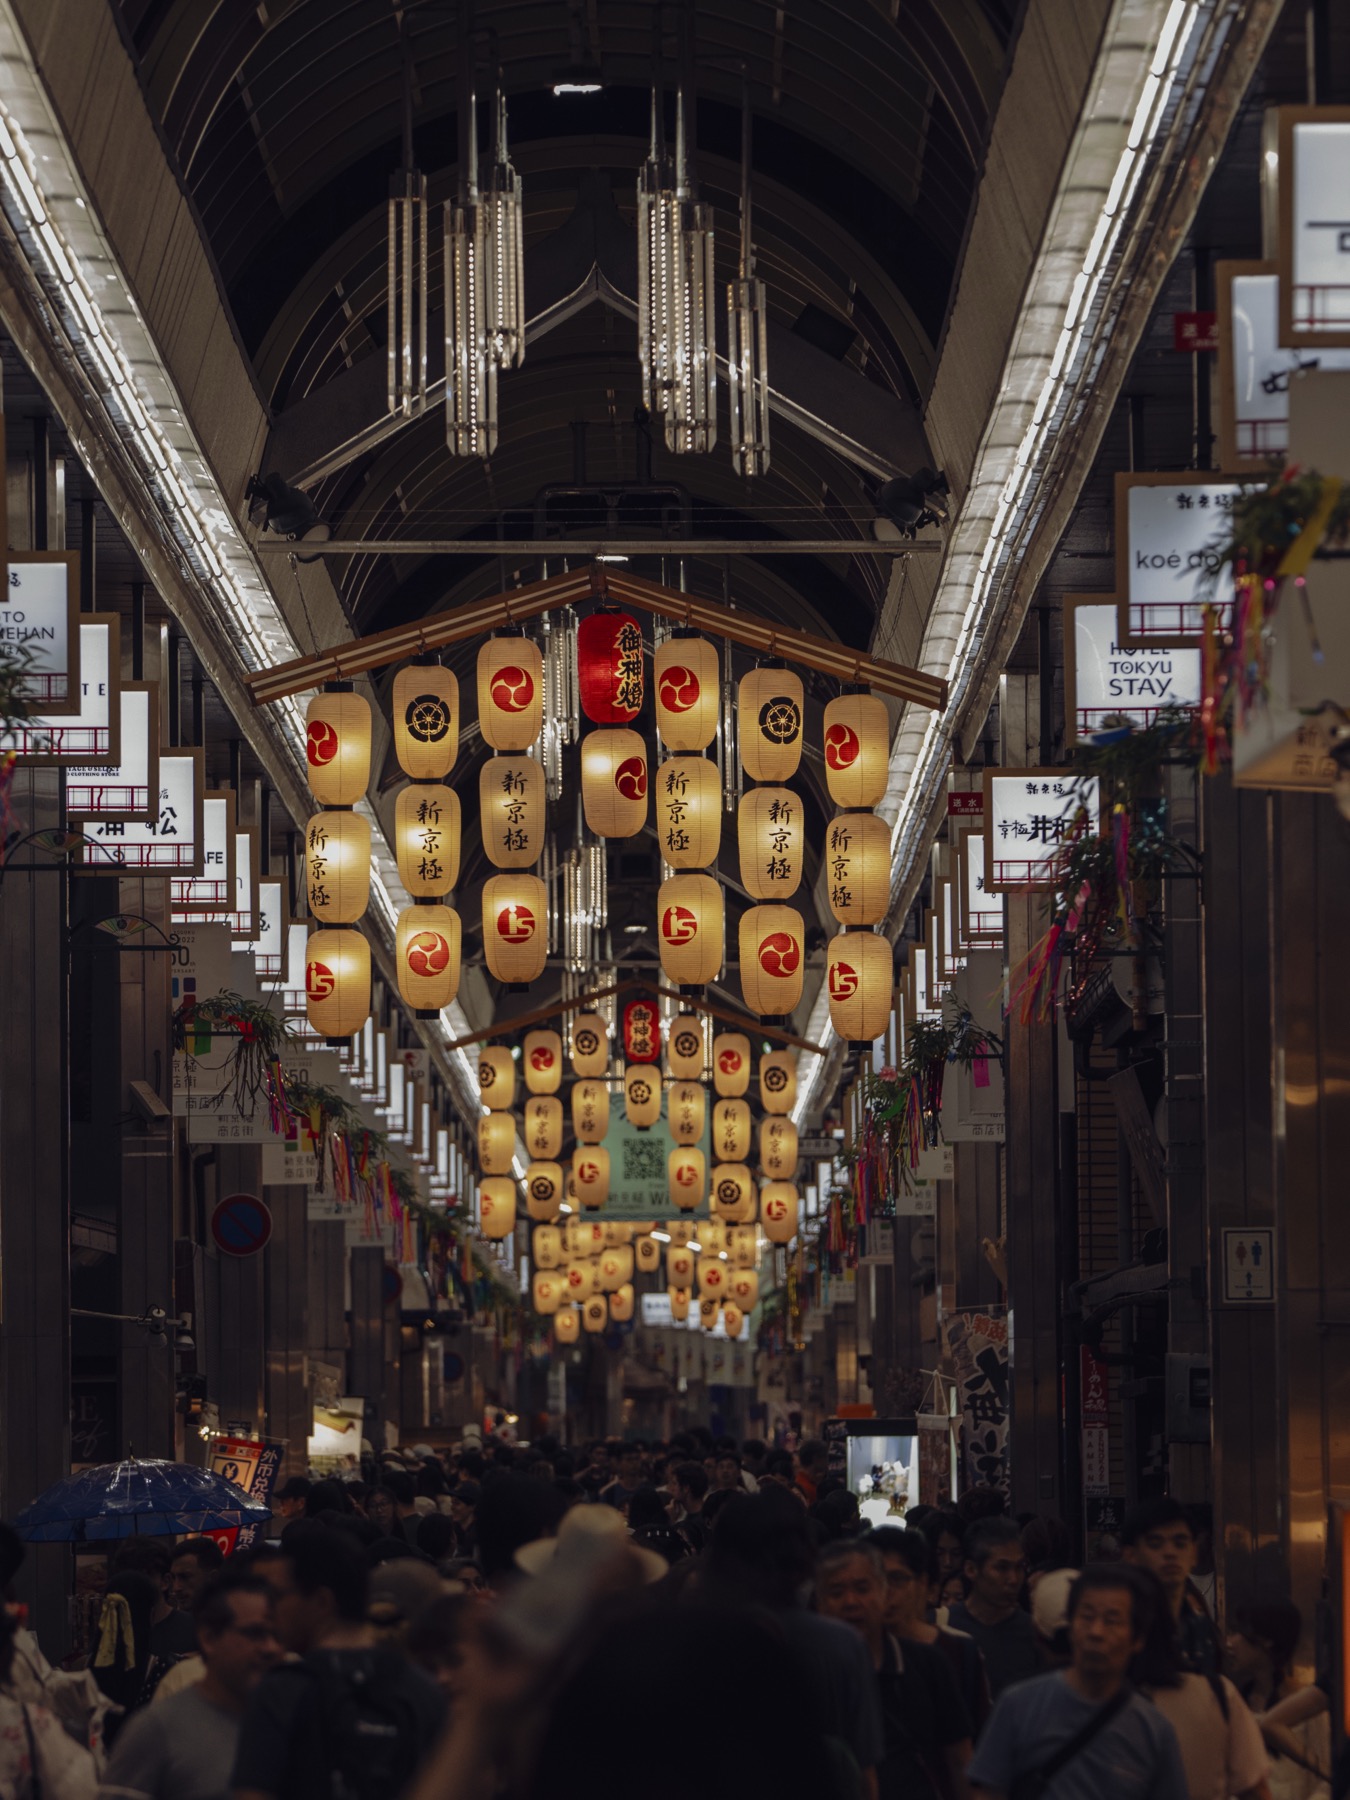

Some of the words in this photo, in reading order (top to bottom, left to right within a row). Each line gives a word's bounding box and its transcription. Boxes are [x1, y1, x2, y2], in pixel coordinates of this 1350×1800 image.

[1136, 550, 1180, 569] koé
[615, 623, 643, 710] 御神燈
[1109, 661, 1172, 674] TOKYU
[1109, 678, 1172, 698] STAY
[415, 799, 443, 881] 新京極
[500, 770, 529, 852] 新京極
[665, 770, 690, 852] 新京極
[766, 799, 793, 881] 新京極
[308, 825, 330, 908] 新京極
[830, 826, 852, 908] 新京極
